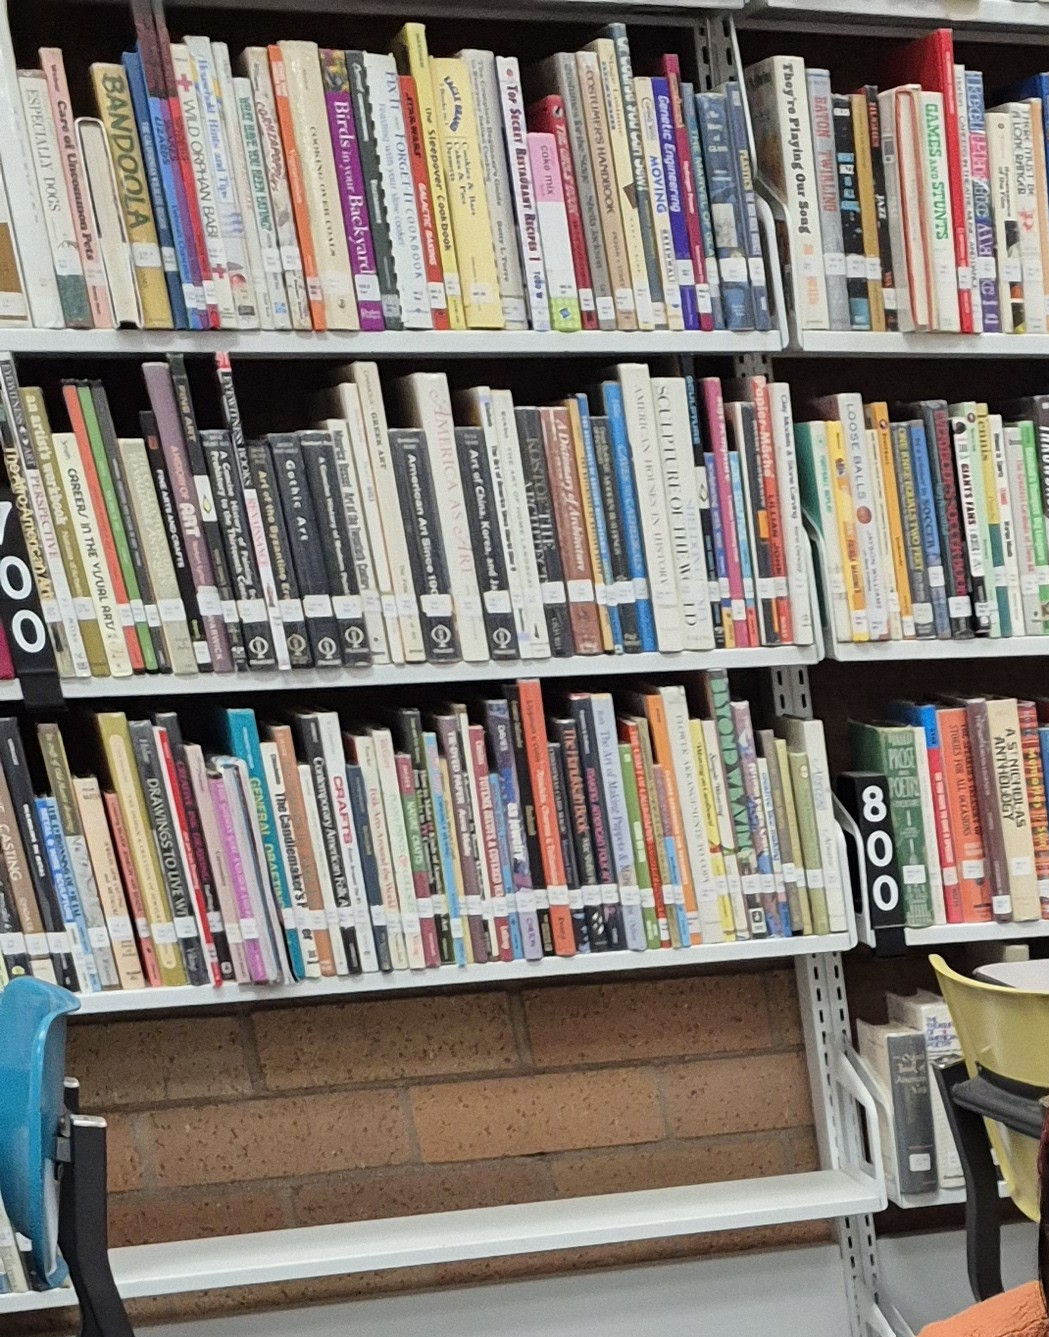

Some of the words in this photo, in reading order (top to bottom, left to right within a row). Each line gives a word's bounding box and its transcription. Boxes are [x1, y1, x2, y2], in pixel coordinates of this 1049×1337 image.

[506, 85, 521, 104] TOP
[782, 63, 798, 114] They're
[57, 100, 74, 133] Care
[183, 100, 200, 137] WILD
[208, 119, 222, 150] Hints
[243, 124, 258, 148] HAVE
[333, 100, 355, 148] Birds
[509, 108, 525, 143] SECRET
[657, 95, 674, 141] Genetic
[814, 96, 831, 138] BATON
[925, 103, 942, 157] GAMES
[26, 89, 53, 170] ESPECIALLY
[42, 176, 61, 212] DOGS
[63, 136, 78, 150] of
[102, 74, 150, 229] BANDOOLA
[309, 126, 325, 180] COOKING
[341, 151, 352, 162] in
[539, 145, 553, 171] cake
[788, 118, 804, 170] Playing
[189, 140, 211, 201] ORPHAN
[250, 170, 266, 194] BEEN
[338, 164, 355, 192] your
[514, 148, 533, 210] RESTAURANT
[543, 174, 557, 195] mix
[595, 150, 616, 214] HANDBOOK
[649, 155, 666, 214] MOVING
[662, 143, 682, 212] Engineering
[795, 174, 808, 197] Our
[818, 150, 837, 213] TWIRLING
[930, 159, 940, 180] AND
[1015, 154, 1027, 195] RANGER
[67, 153, 89, 230] Uncommon
[320, 183, 331, 217] OVER
[418, 182, 433, 229] GALACTIC
[427, 129, 444, 191] Sleepover
[437, 195, 451, 252] Cookbook
[875, 194, 887, 219] JAZZ
[932, 181, 949, 240] STUNTS
[253, 195, 273, 232] EATING?
[348, 194, 375, 273] Backyard
[522, 214, 538, 251] RECIPES
[797, 201, 811, 234] Song
[78, 232, 95, 261] Pets
[325, 220, 336, 257] COALS
[405, 208, 422, 280] COOKBOOK
[26, 395, 40, 416] an
[177, 385, 191, 415] FINE
[184, 417, 196, 442] ART
[556, 419, 569, 431] A
[633, 383, 651, 452] AMERICAN
[31, 418, 56, 460] artist's
[222, 376, 241, 446] EYEWITNESS
[235, 447, 249, 490] BOOKS
[371, 412, 384, 446] GREEK
[378, 450, 387, 470] ART
[656, 385, 684, 493] SCULPTURE
[846, 403, 861, 451] LOOSE
[469, 450, 482, 471] Art
[557, 434, 578, 489] Dictionary
[780, 394, 790, 413] Clay
[787, 486, 799, 519] Carving
[42, 462, 68, 525] workbook
[67, 468, 88, 519] CAREERS
[157, 470, 168, 490] FINE
[407, 454, 425, 516] American
[429, 390, 459, 490] AMERICA
[453, 526, 472, 576] ART
[473, 473, 484, 486] of
[644, 459, 659, 508] HOUSES
[852, 455, 867, 501] BALLS
[960, 463, 973, 499] GIANTS
[29, 475, 60, 559] PERSPECTIVE
[161, 490, 173, 513] ARTS
[178, 502, 200, 538] ART
[285, 459, 303, 509] Gothic
[297, 516, 310, 542] Art
[475, 487, 490, 518] China,
[651, 513, 662, 525] IN
[671, 496, 685, 520] OF
[965, 501, 977, 525] FANS
[165, 513, 177, 532] AND
[257, 470, 270, 488] Art
[268, 524, 287, 581] Byzantine
[417, 518, 430, 536] Art
[480, 520, 494, 556] Korea,
[568, 507, 586, 572] Architecture
[674, 526, 691, 557] THE
[85, 537, 99, 558] THE
[168, 531, 185, 568] CRAFTS
[421, 537, 435, 573] Since
[485, 557, 497, 576] and
[654, 532, 669, 584] HISTORY
[91, 562, 108, 602] VISUAL
[101, 605, 117, 632] ARTS
[1004, 728, 1017, 738] A
[313, 757, 335, 827] Contemporary
[563, 729, 577, 752] The
[573, 805, 589, 835] Book
[608, 780, 624, 815] Making
[949, 725, 964, 757] STORIES
[957, 795, 972, 836] OCCASIONS
[994, 736, 1014, 821] ANTHOLOGY
[1007, 759, 1026, 828] NICHOLAS
[146, 778, 175, 849] DRAWINGS
[251, 778, 270, 835] GENERAL
[275, 791, 289, 813] The
[333, 775, 353, 845] CRAFTS
[405, 800, 419, 832] NATURE
[0, 823, 22, 881] CASTING
[324, 828, 345, 876] American
[410, 835, 423, 865] CRAFTS
[610, 817, 627, 853] Puppets
[862, 785, 899, 911] 800
[162, 851, 176, 868] TO
[280, 814, 310, 900] Candlemaker's
[167, 871, 184, 897] LIVE
[334, 877, 348, 897] Folk
[381, 881, 396, 909] World
